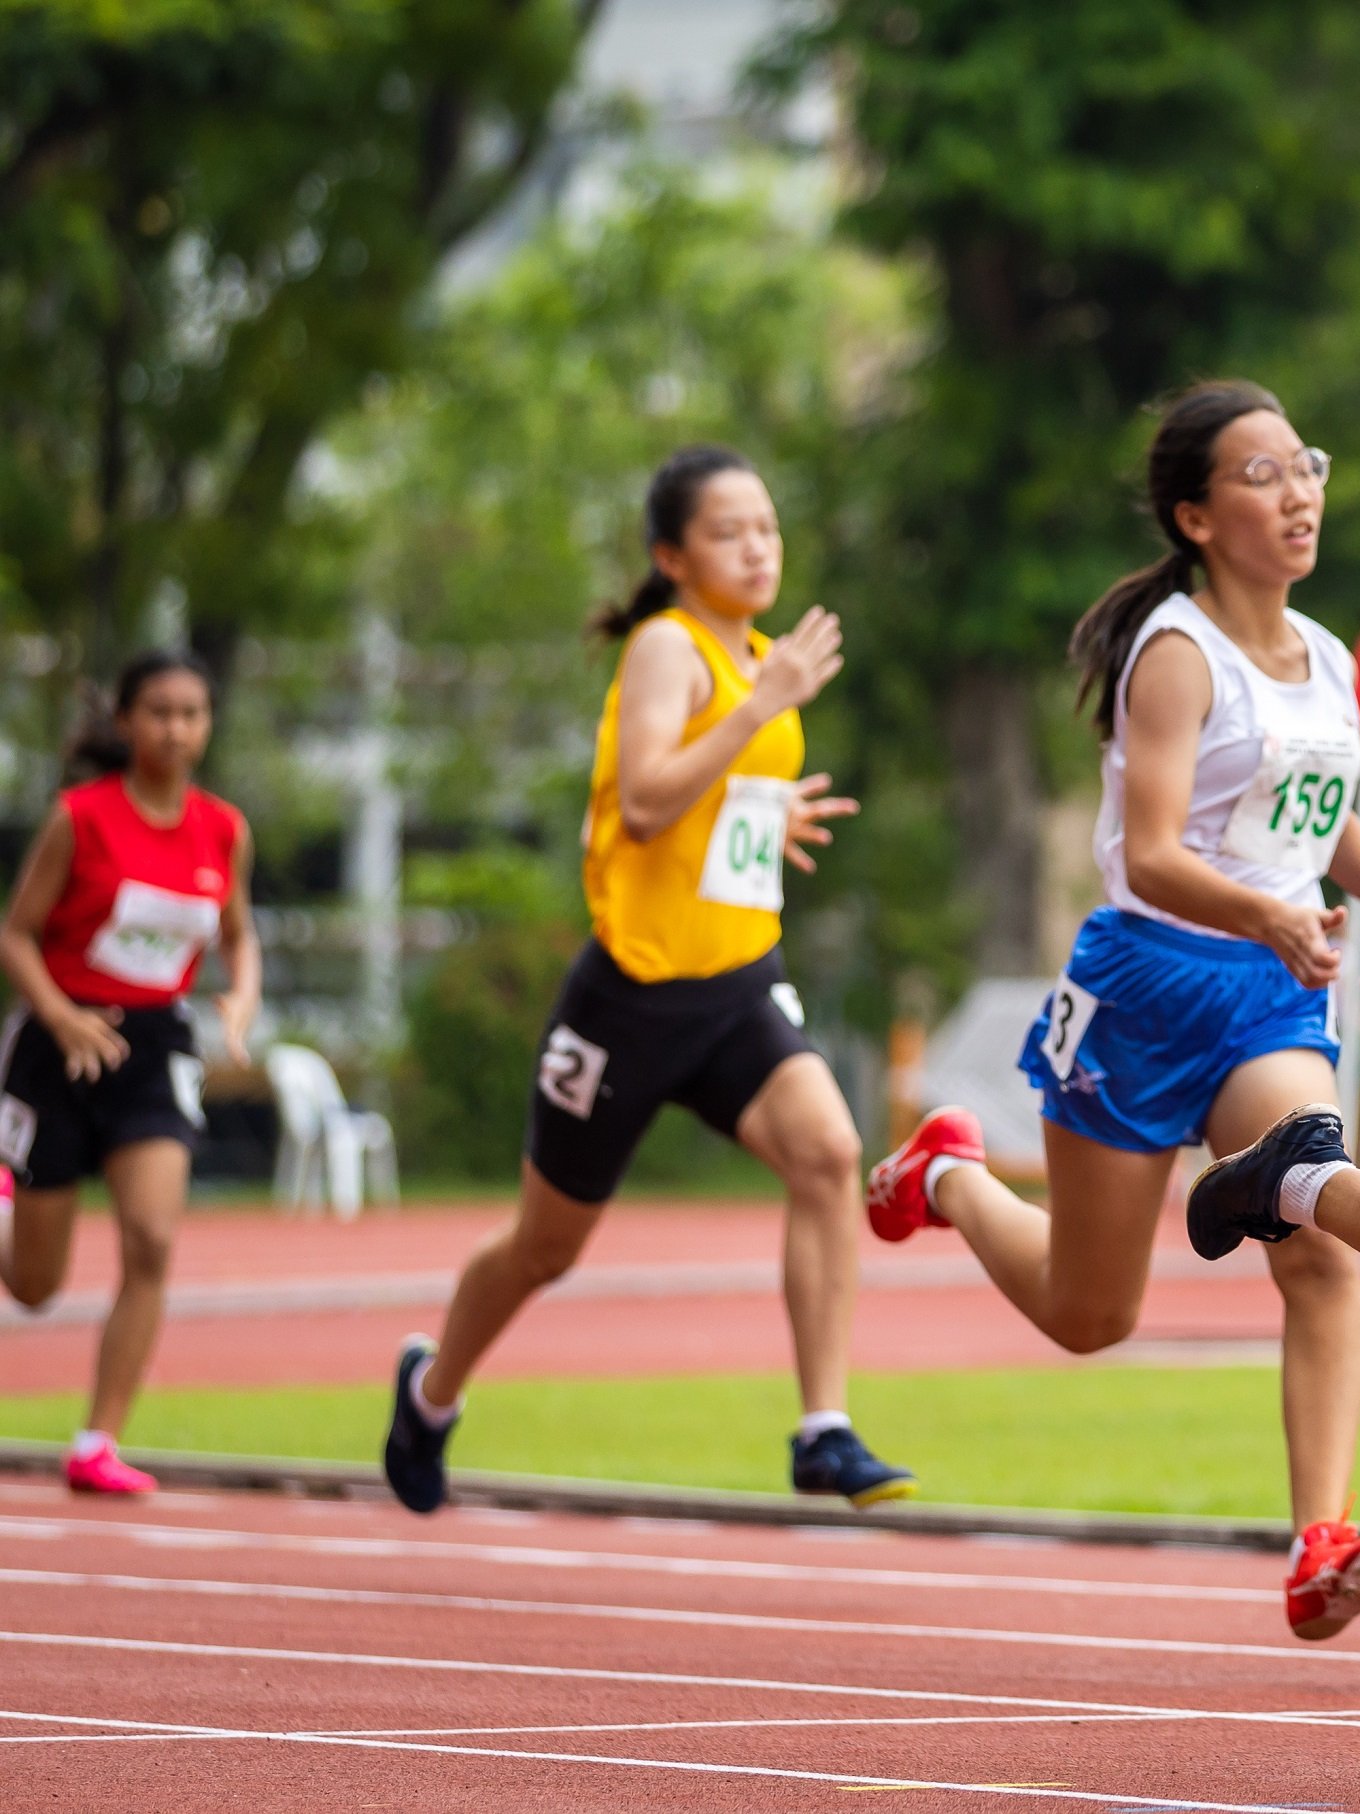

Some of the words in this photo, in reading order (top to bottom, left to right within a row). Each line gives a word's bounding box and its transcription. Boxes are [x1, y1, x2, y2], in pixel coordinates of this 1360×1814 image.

[1268, 772, 1345, 838] 159
[1055, 991, 1075, 1055] 3
[551, 1046, 585, 1101] 2
